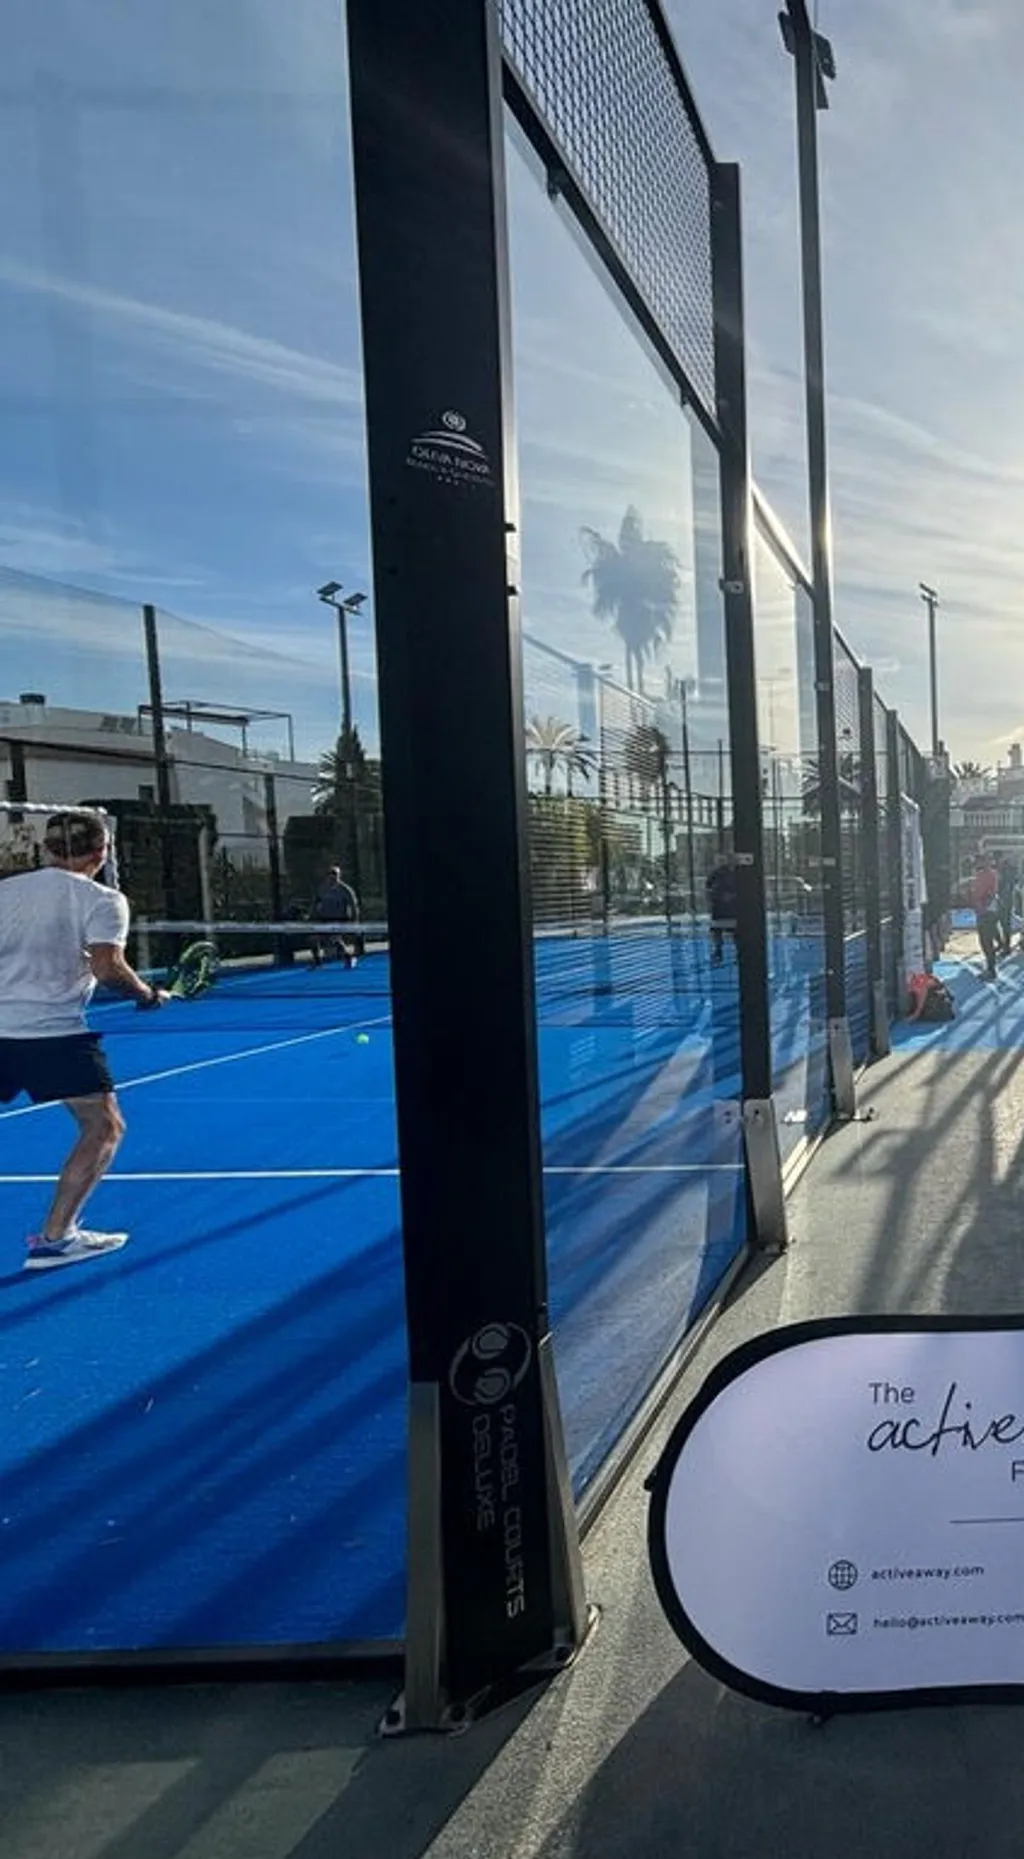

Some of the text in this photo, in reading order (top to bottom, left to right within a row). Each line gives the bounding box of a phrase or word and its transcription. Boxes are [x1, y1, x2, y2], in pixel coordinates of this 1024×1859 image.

[868, 1382, 915, 1404] The
[499, 1403, 525, 1619] PADEL COURTS
[871, 1564, 985, 1580] activeaway.com
